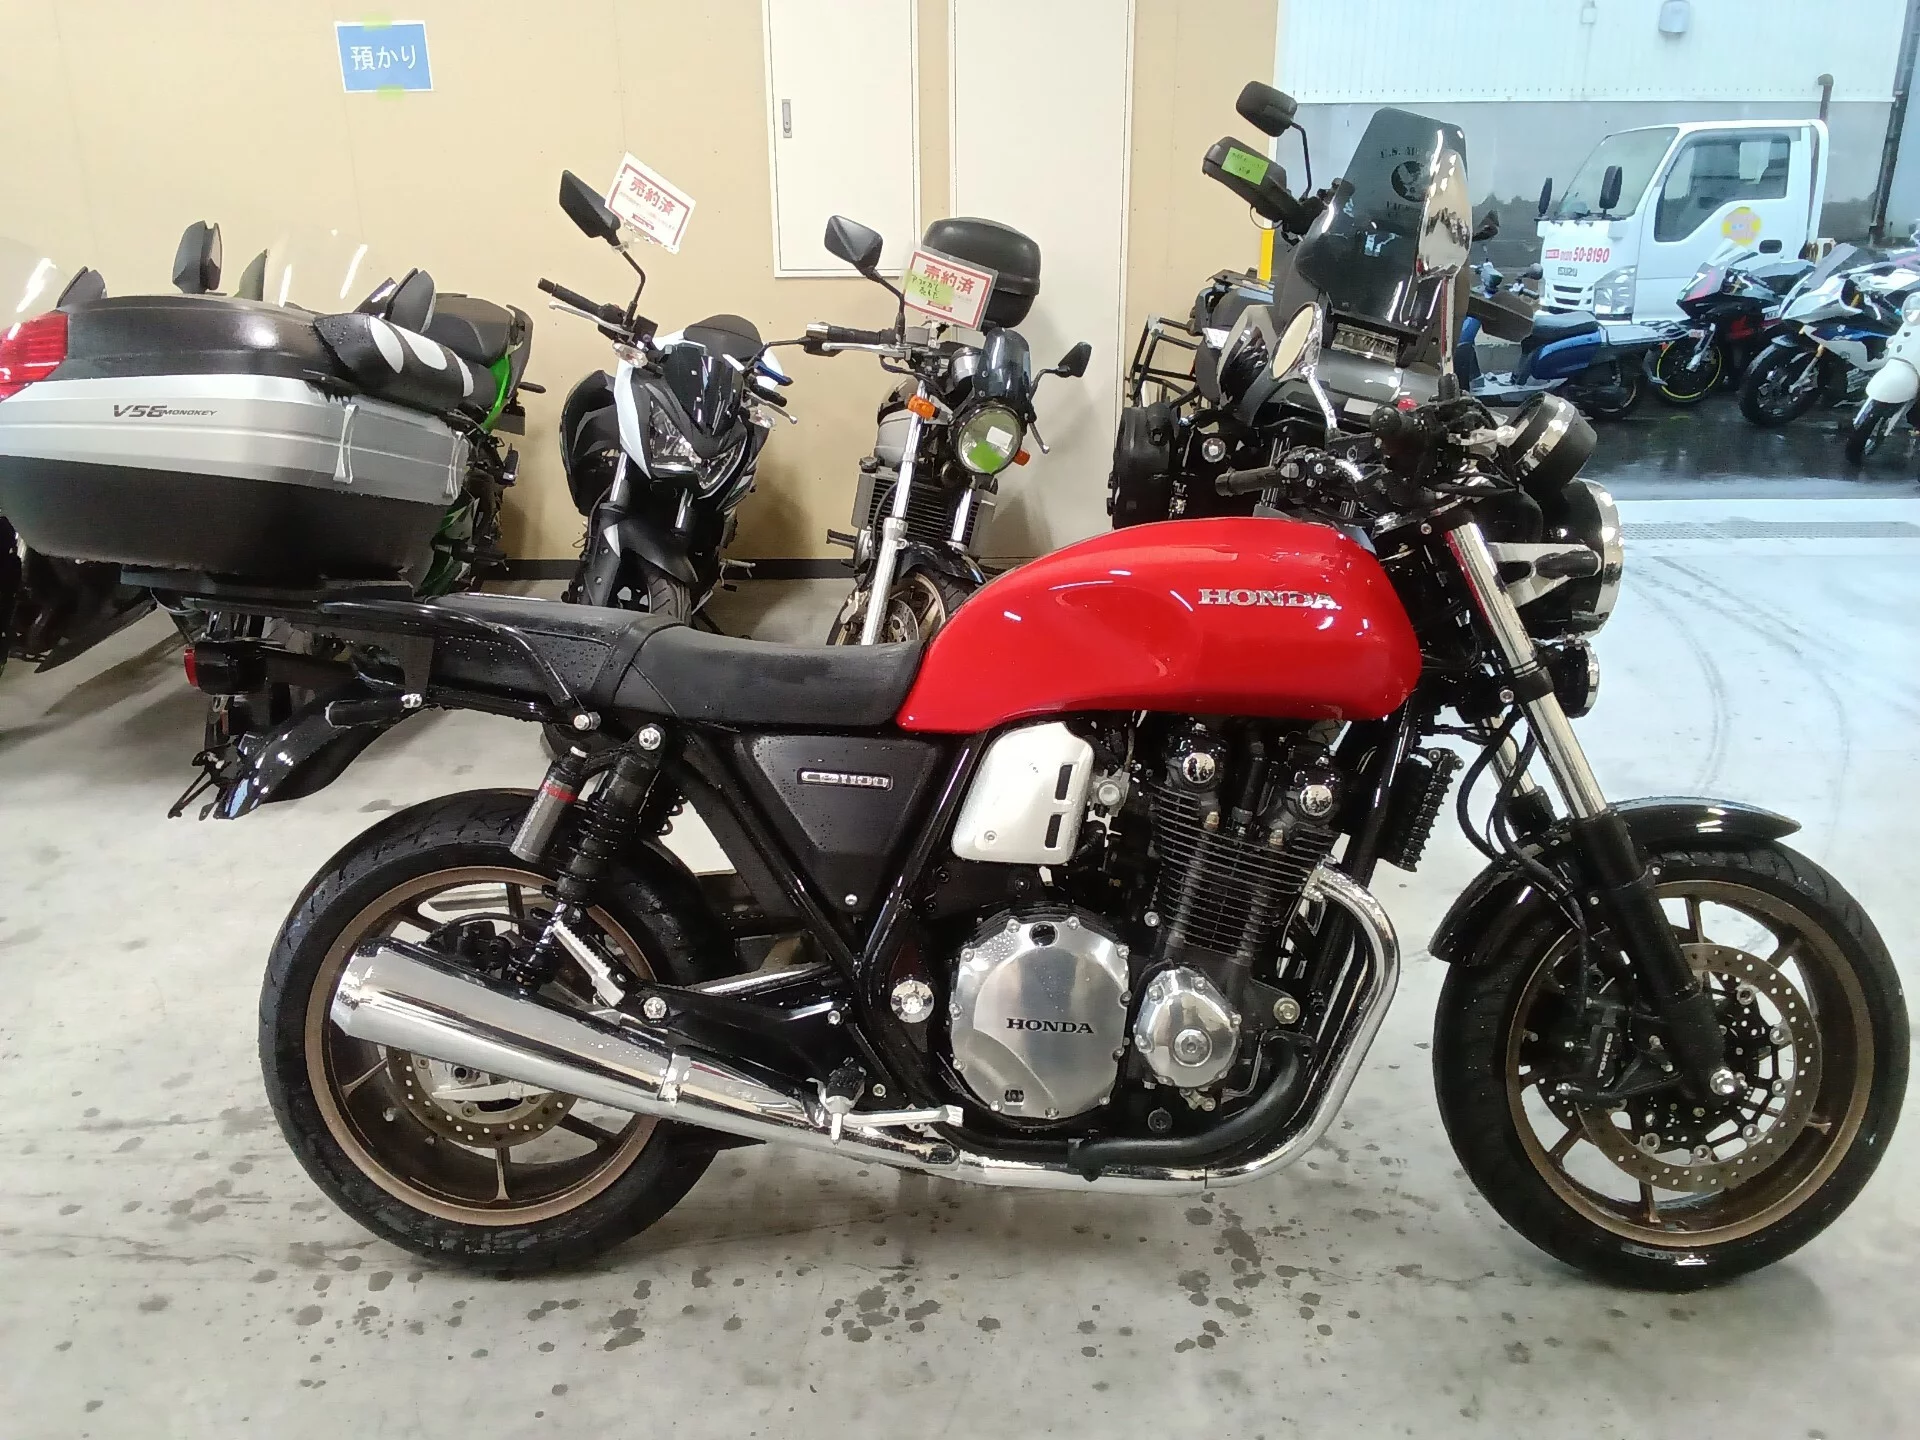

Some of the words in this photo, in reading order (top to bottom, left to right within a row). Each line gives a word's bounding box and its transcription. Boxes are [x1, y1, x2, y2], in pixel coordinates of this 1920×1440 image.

[350, 44, 417, 71] 預かり
[629, 176, 676, 216] 売約済
[1573, 246, 1610, 263] 50-8190
[924, 264, 976, 295] 売約済
[161, 409, 218, 417] MONOKEY
[1198, 588, 1342, 610] HONDA
[1006, 1018, 1094, 1034] HONDA
